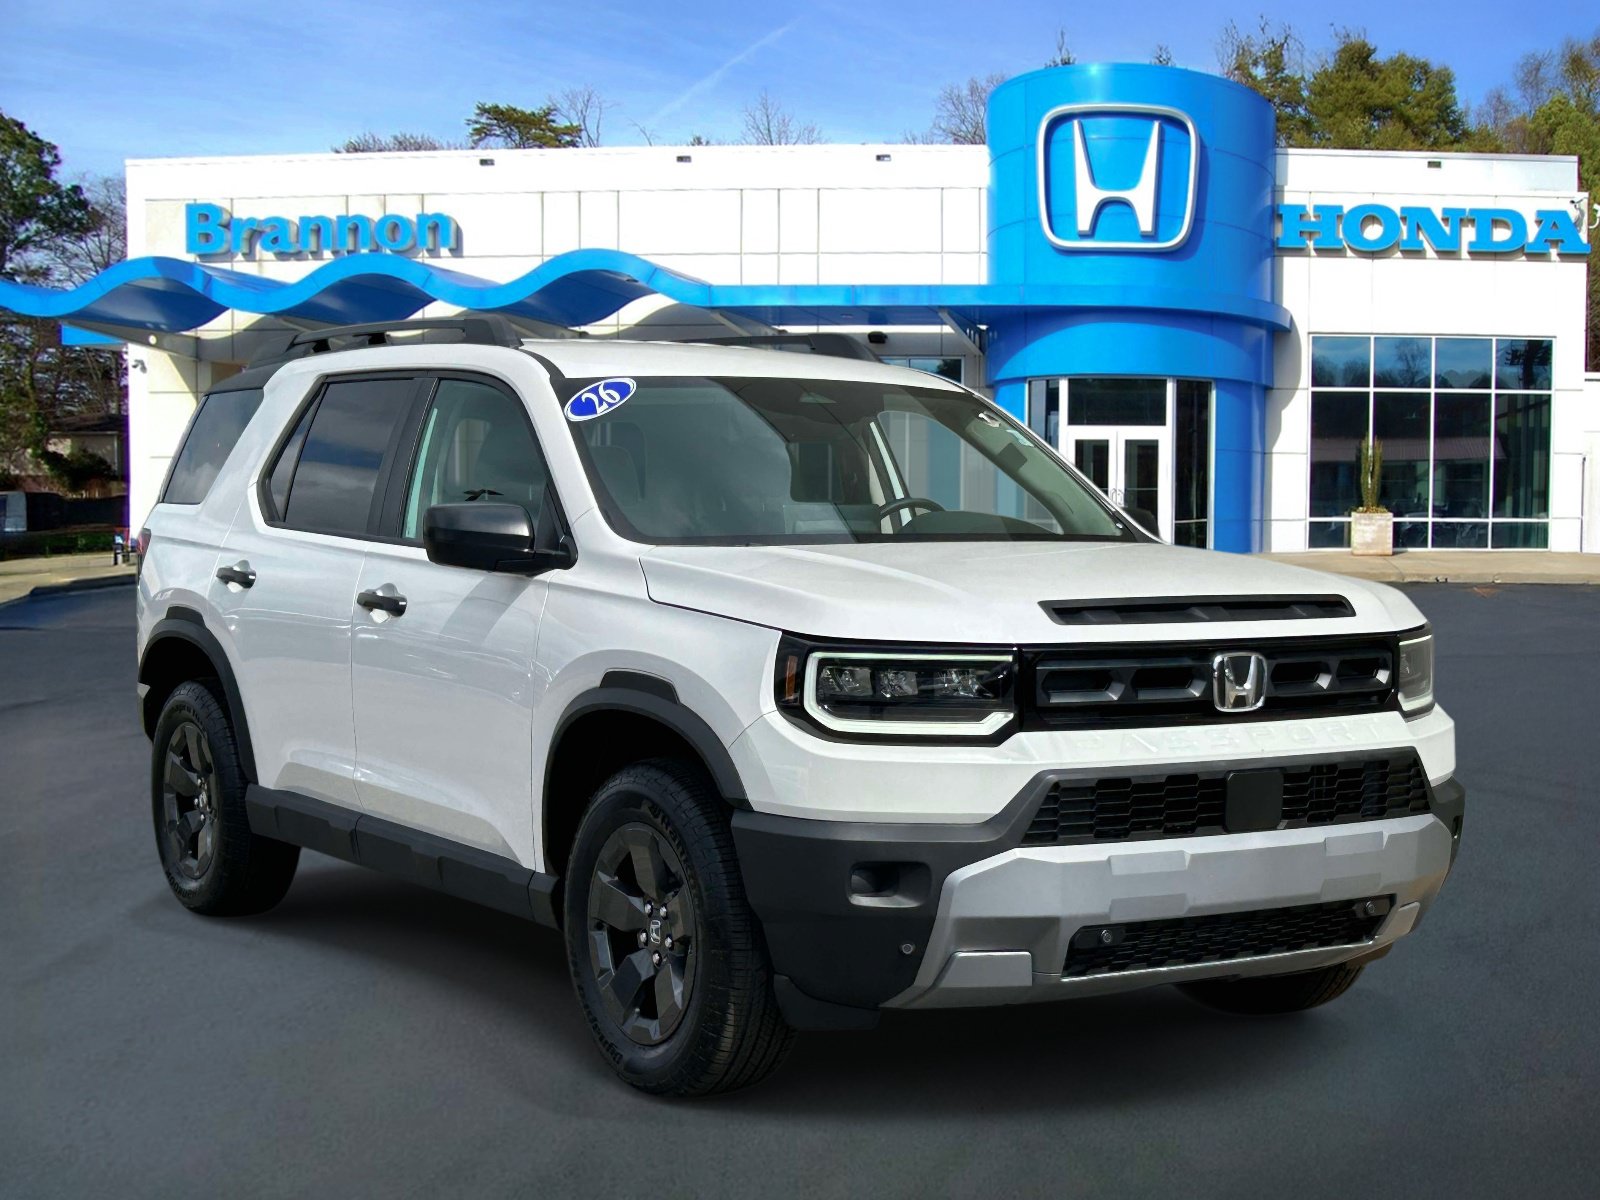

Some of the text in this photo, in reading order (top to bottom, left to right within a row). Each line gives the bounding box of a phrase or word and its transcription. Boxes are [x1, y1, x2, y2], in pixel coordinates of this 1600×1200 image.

[186, 203, 453, 254] Brannon
[1277, 203, 1592, 255] HONDA
[581, 382, 621, 414] 26
[1074, 717, 1382, 754] PASSPORT
